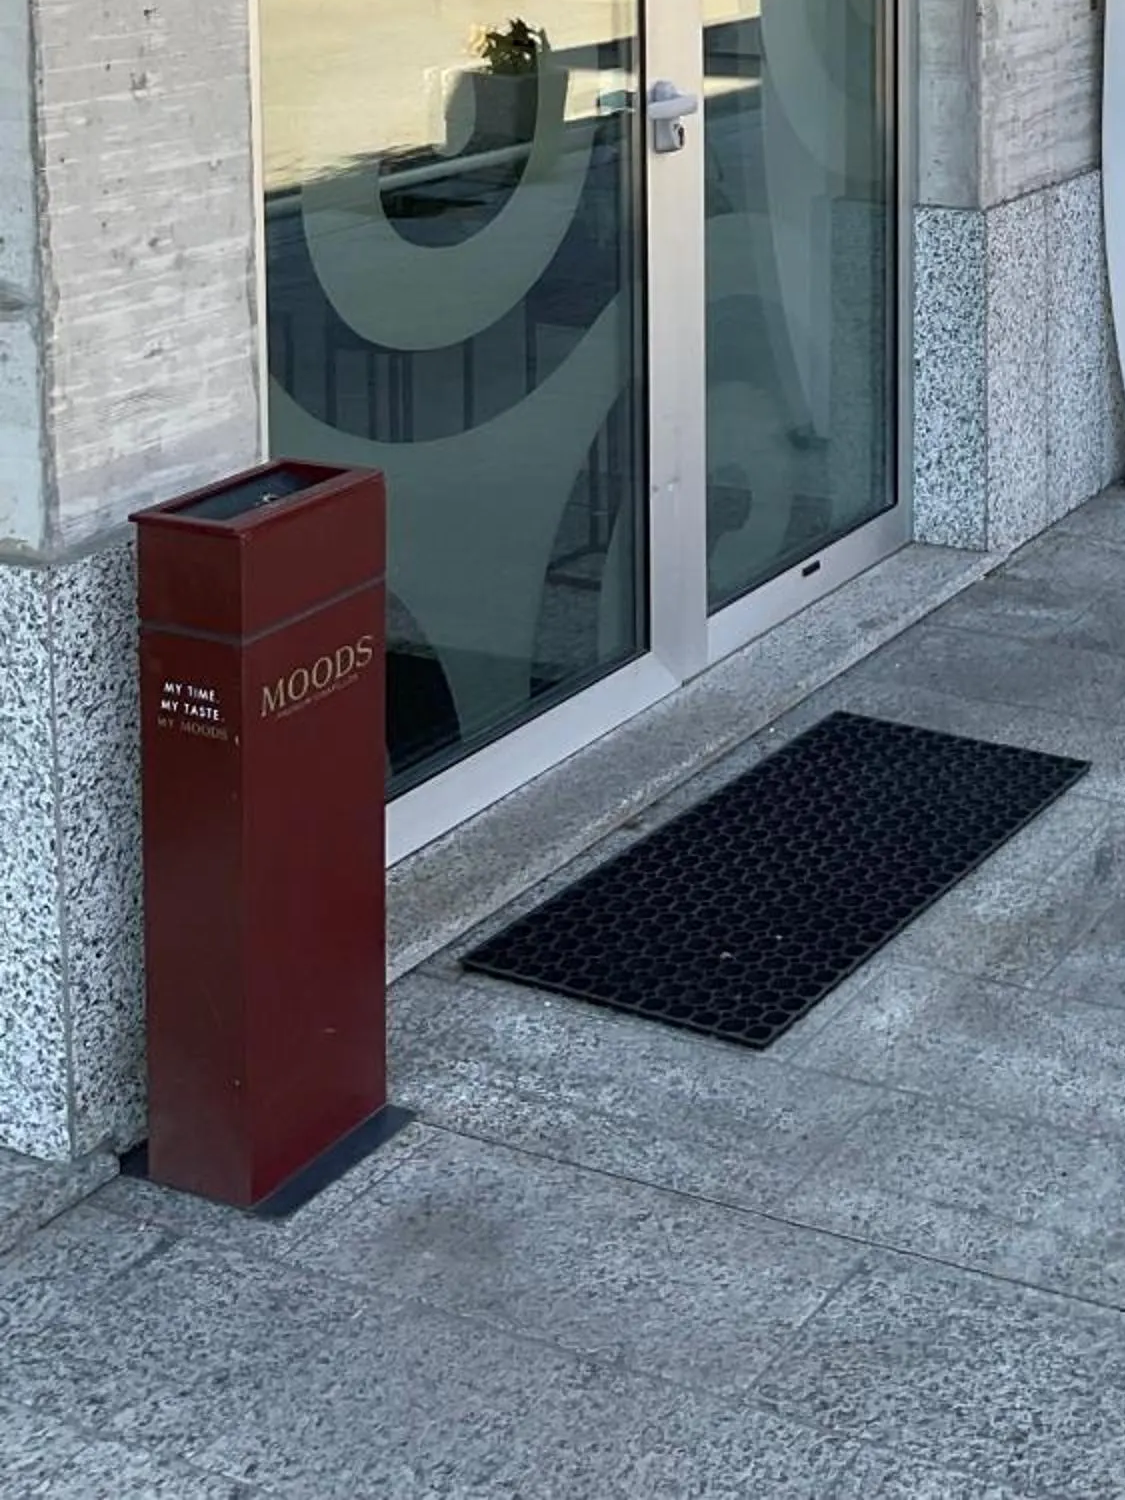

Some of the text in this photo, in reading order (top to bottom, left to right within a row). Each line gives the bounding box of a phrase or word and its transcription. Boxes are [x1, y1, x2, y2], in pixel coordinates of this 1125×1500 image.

[260, 634, 375, 717] MOODS
[163, 681, 183, 697] MY
[160, 699, 180, 713] MY
[157, 715, 174, 729] MY
